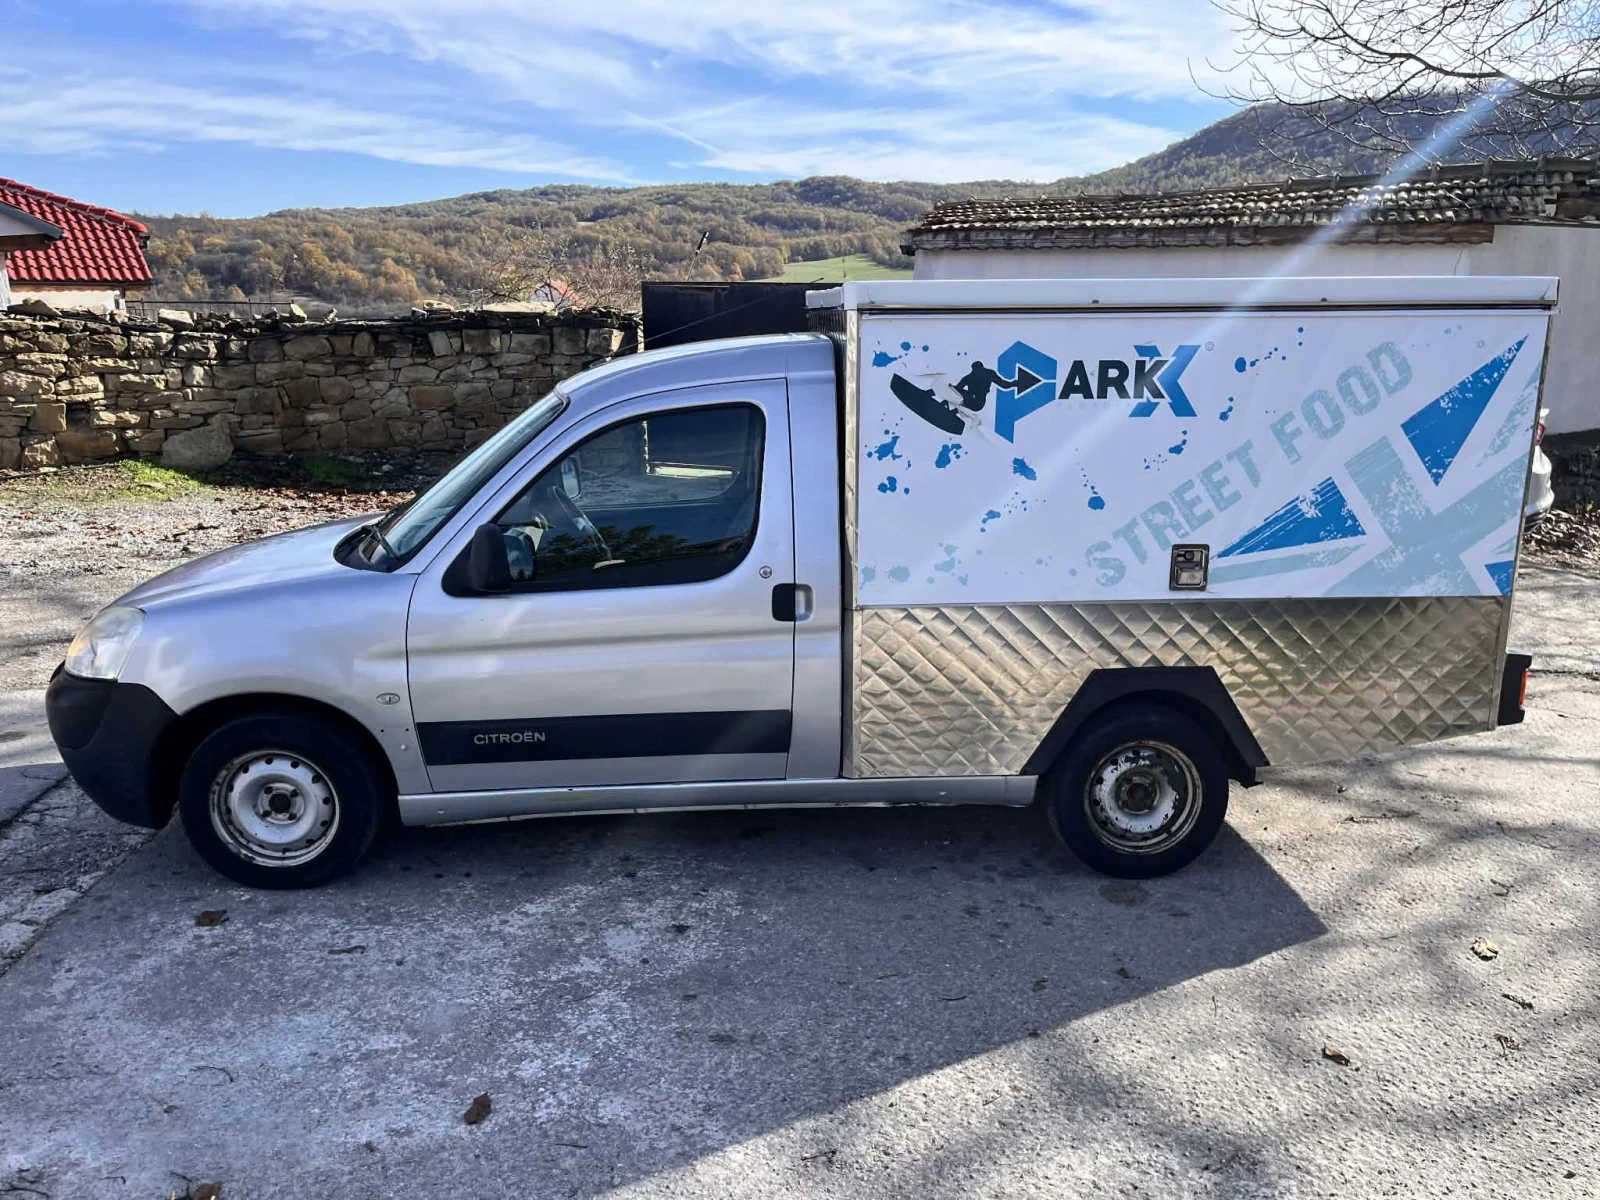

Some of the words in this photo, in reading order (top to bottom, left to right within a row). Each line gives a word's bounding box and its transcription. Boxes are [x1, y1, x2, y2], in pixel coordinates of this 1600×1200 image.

[1084, 439, 1261, 588] STREET
[1270, 341, 1413, 465] FOOD
[473, 730, 546, 745] CITROËN
